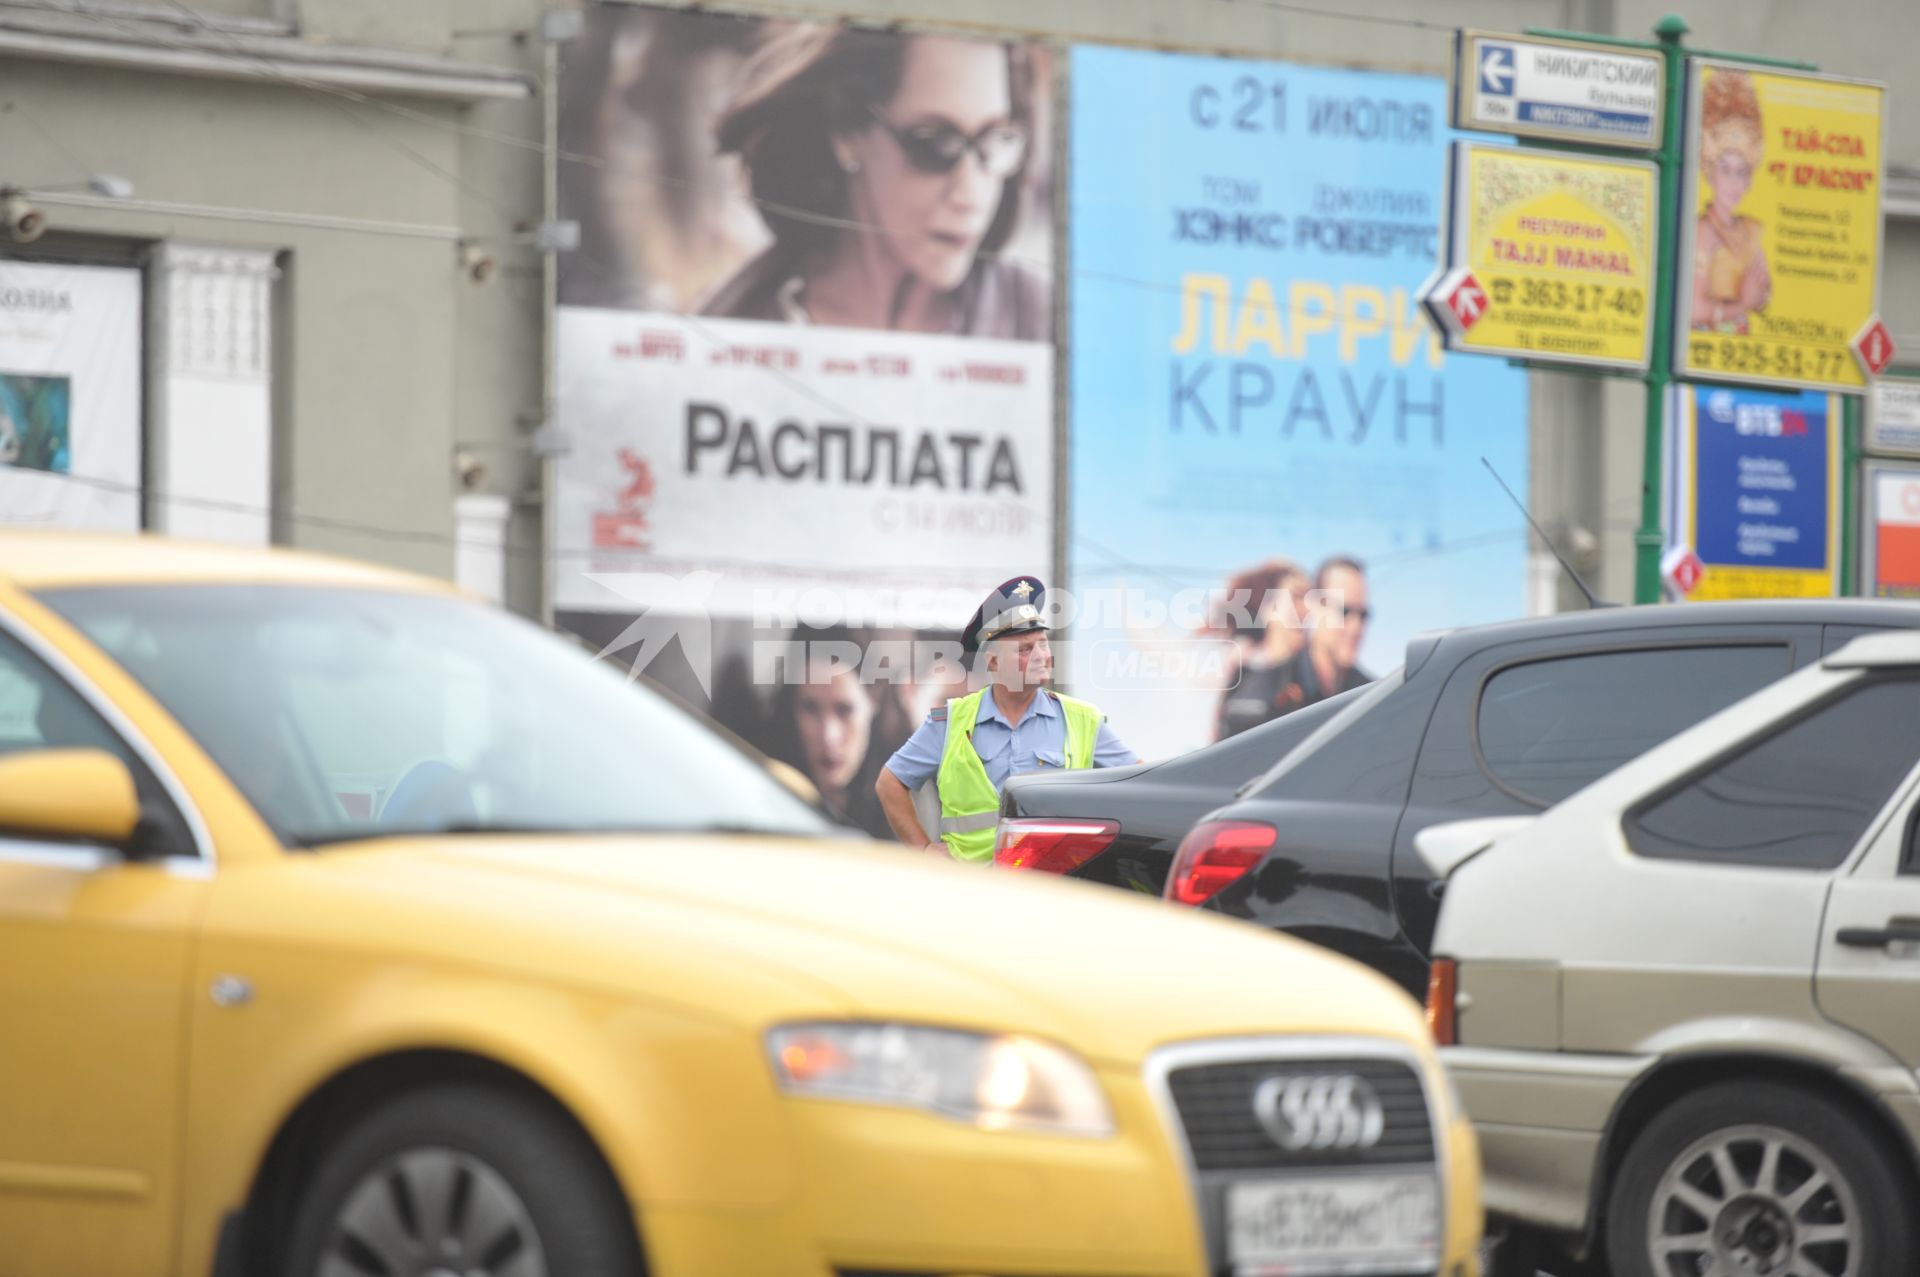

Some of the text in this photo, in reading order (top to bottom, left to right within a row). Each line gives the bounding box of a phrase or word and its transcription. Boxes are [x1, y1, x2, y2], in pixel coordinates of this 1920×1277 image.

[1232, 76, 1288, 134] 21
[1173, 207, 1287, 249] ХЭНКС
[1172, 271, 1446, 369] ЛАРРИ
[1169, 359, 1446, 449] КРАУН
